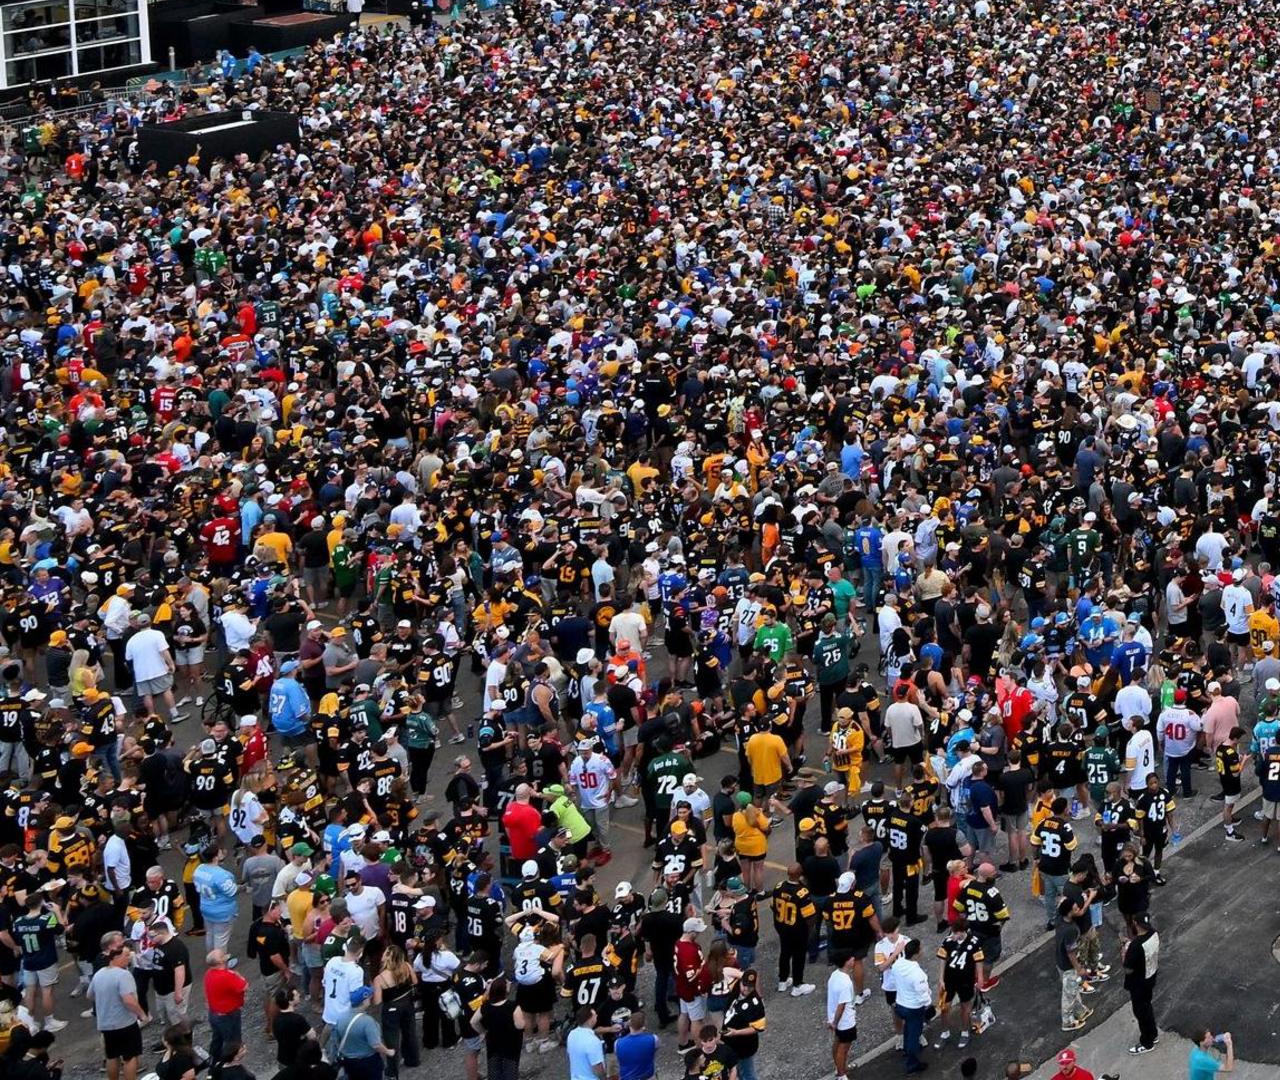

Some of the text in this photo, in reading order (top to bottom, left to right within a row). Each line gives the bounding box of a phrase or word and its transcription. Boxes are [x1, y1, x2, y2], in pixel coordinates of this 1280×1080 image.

[264, 312, 276, 323] 33
[159, 398, 172, 410] 15
[1057, 430, 1070, 443] 90
[21, 454, 28, 466] 7
[213, 529, 230, 546] 42
[104, 572, 112, 585] 8
[742, 606, 754, 624] 27
[1228, 604, 1234, 616] 4
[20, 615, 38, 632] 90
[504, 688, 518, 702] 90
[2, 710, 18, 726] 19
[98, 714, 112, 734] 43
[1053, 758, 1064, 774] 4
[1088, 764, 1108, 783] 25
[196, 775, 214, 790] 90
[580, 773, 598, 788] 90
[660, 775, 680, 794] 72
[232, 809, 246, 828] 92
[1148, 802, 1164, 821] 43
[889, 829, 907, 850] 58
[1042, 831, 1062, 857] 36
[775, 899, 797, 925] 90
[832, 910, 854, 930] 97
[395, 911, 406, 932] 18
[22, 933, 39, 952] 11
[519, 959, 528, 974] 3
[950, 950, 967, 970] 24
[328, 978, 336, 998] 1
[578, 978, 602, 1005] 67
